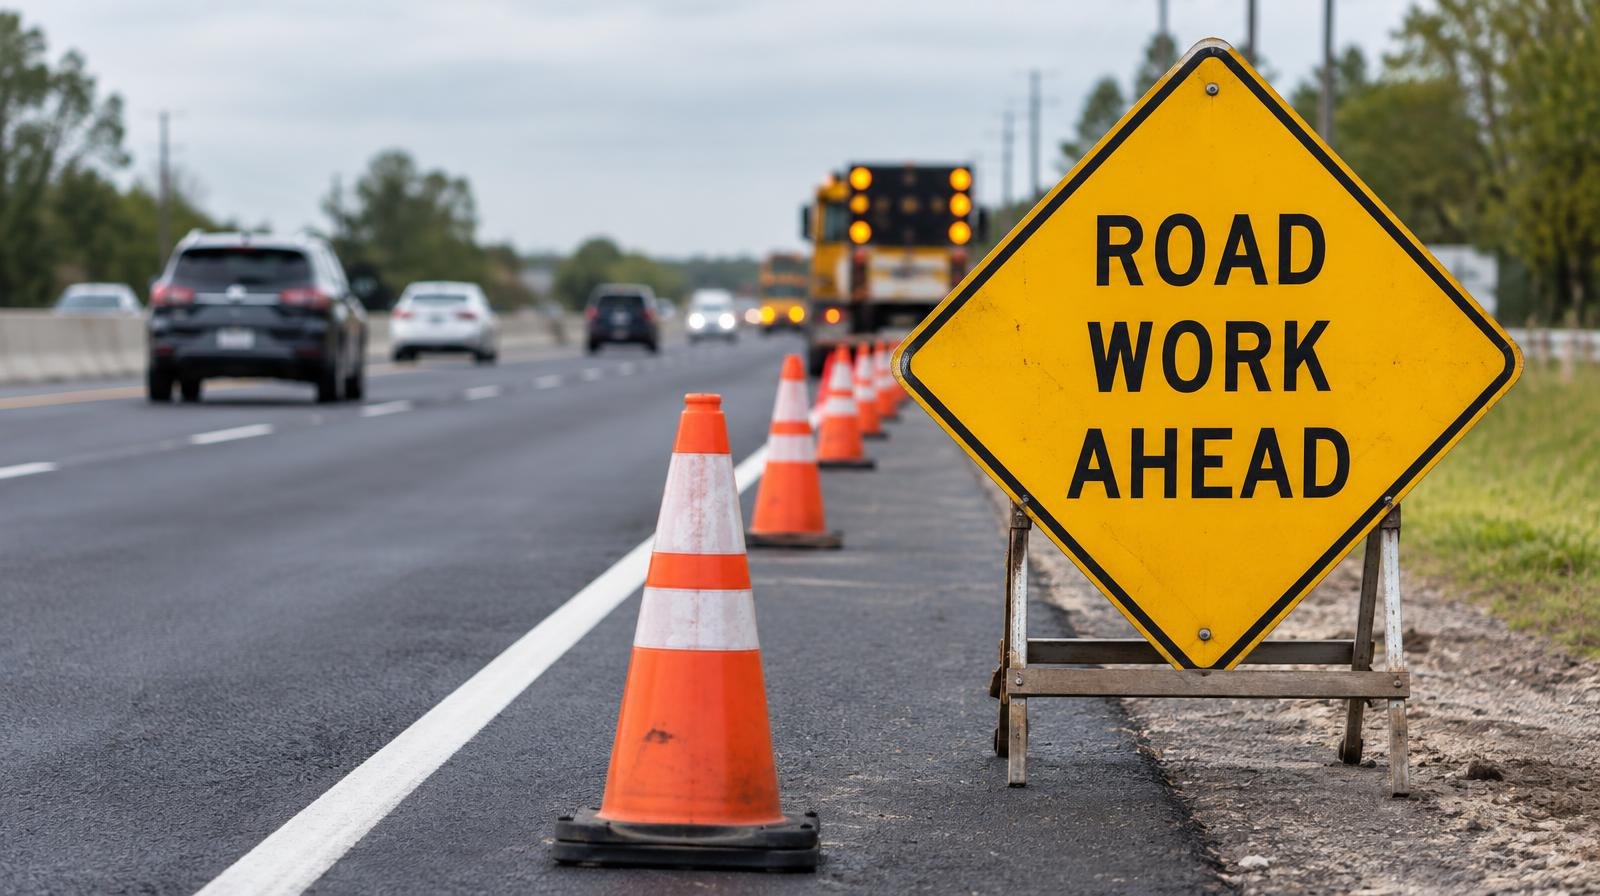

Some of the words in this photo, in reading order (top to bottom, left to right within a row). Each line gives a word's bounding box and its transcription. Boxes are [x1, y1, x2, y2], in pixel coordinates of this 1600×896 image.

[1096, 213, 1326, 286] ROAD
[1087, 319, 1332, 394] WORK
[1066, 427, 1351, 499] AHEAD
